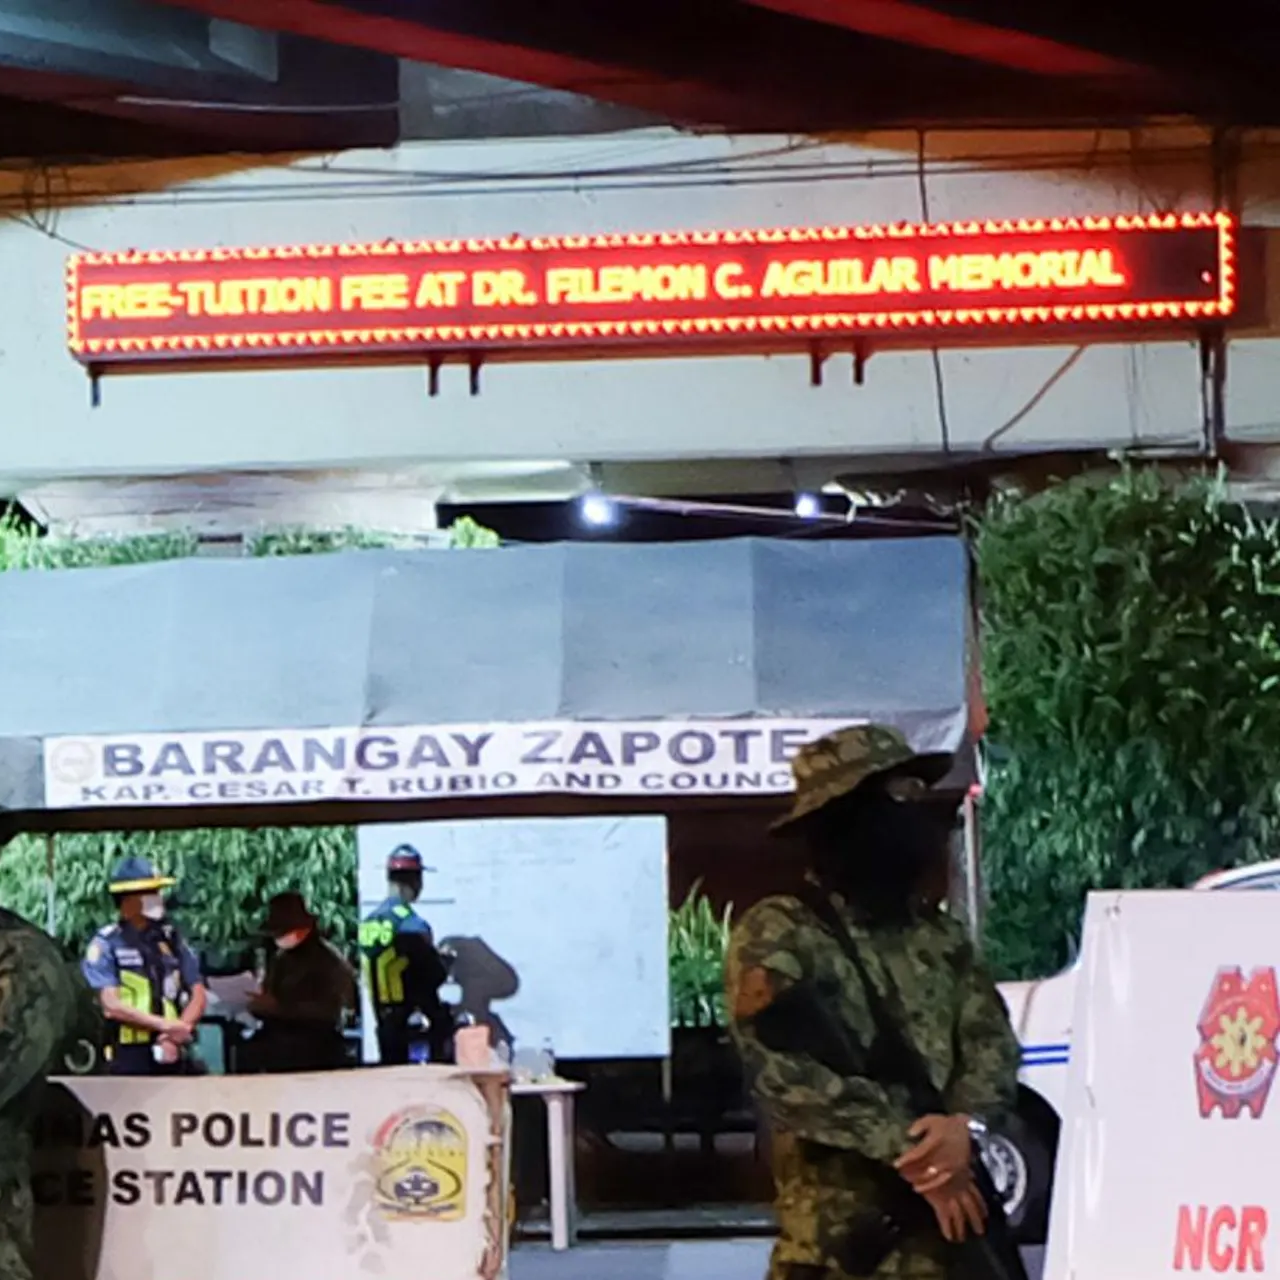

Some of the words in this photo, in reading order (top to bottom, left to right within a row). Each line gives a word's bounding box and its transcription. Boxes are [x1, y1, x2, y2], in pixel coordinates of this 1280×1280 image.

[81, 276, 331, 320] FREE-TUITION
[341, 273, 408, 310] FEE
[415, 271, 466, 306] AT
[471, 268, 538, 305] DR.
[547, 261, 706, 303] FILEMON
[715, 263, 752, 298] C.
[761, 257, 918, 296] AGUILAR
[929, 249, 1124, 290] MEMORIAL
[103, 732, 494, 777] BARANGAY
[519, 728, 808, 766] ZAPOTE
[80, 782, 169, 802] KAP.
[188, 778, 325, 800] CESAR
[342, 777, 372, 796] T.
[389, 772, 518, 794] RUBIO
[535, 771, 622, 791] AND
[639, 768, 791, 788] COUNC
[170, 1112, 351, 1148] POLICE
[112, 1169, 325, 1206] STATION
[1173, 1204, 1268, 1273] NCR
